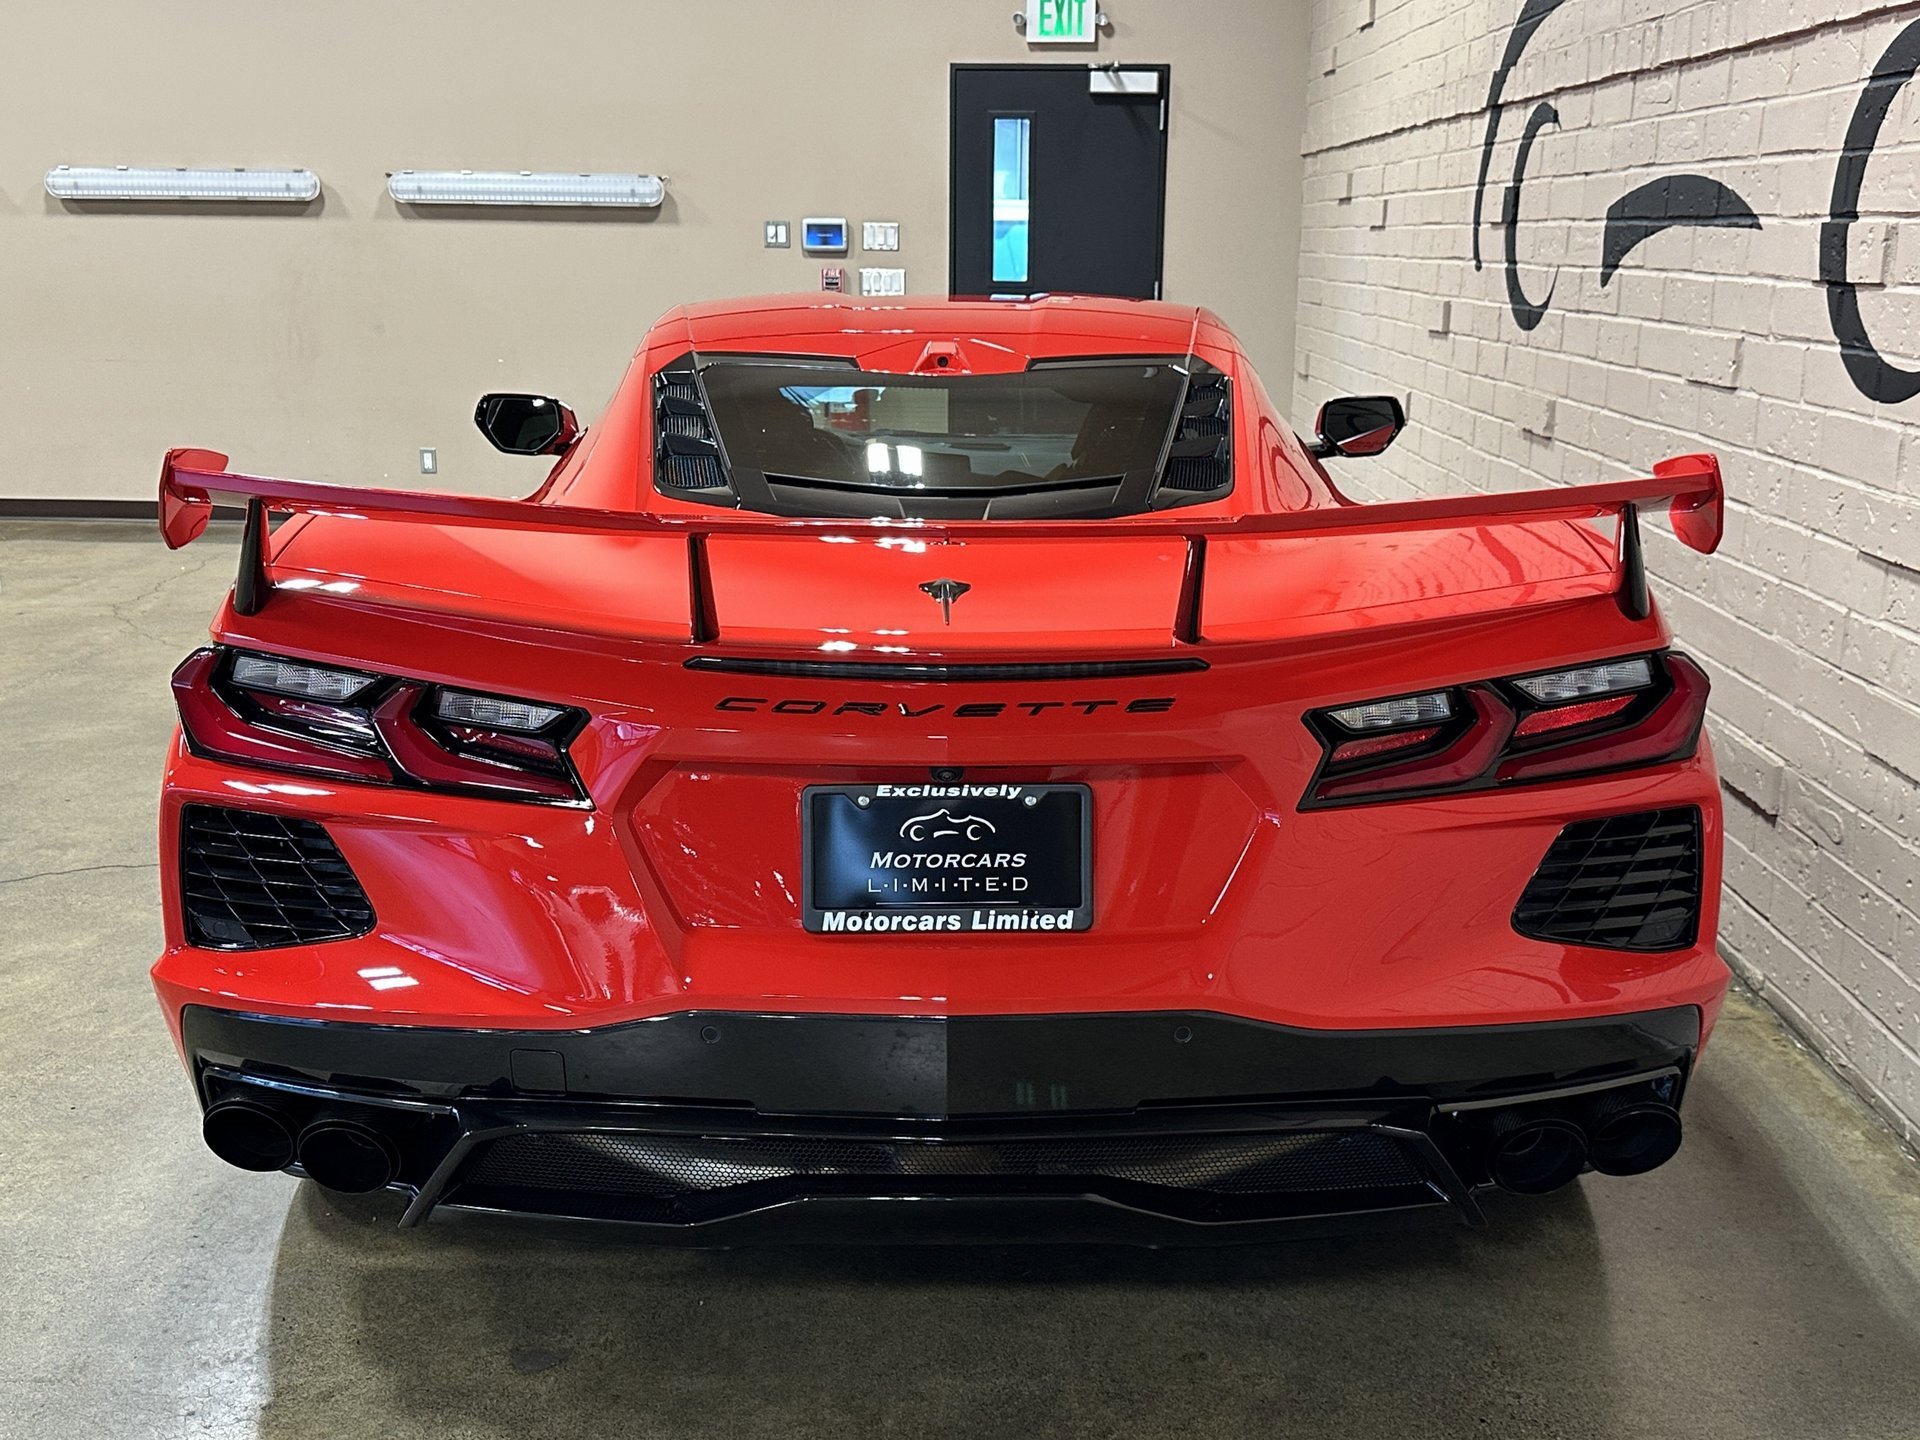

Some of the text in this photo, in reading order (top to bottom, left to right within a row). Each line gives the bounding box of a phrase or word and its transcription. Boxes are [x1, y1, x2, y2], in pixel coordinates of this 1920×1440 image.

[1039, 0, 1087, 36] EXIT
[714, 696, 1176, 718] CORVETTE
[876, 784, 1022, 800] Exclusively
[870, 852, 1027, 869] MOTORCARS
[822, 910, 1074, 931] Motorcars Limited
